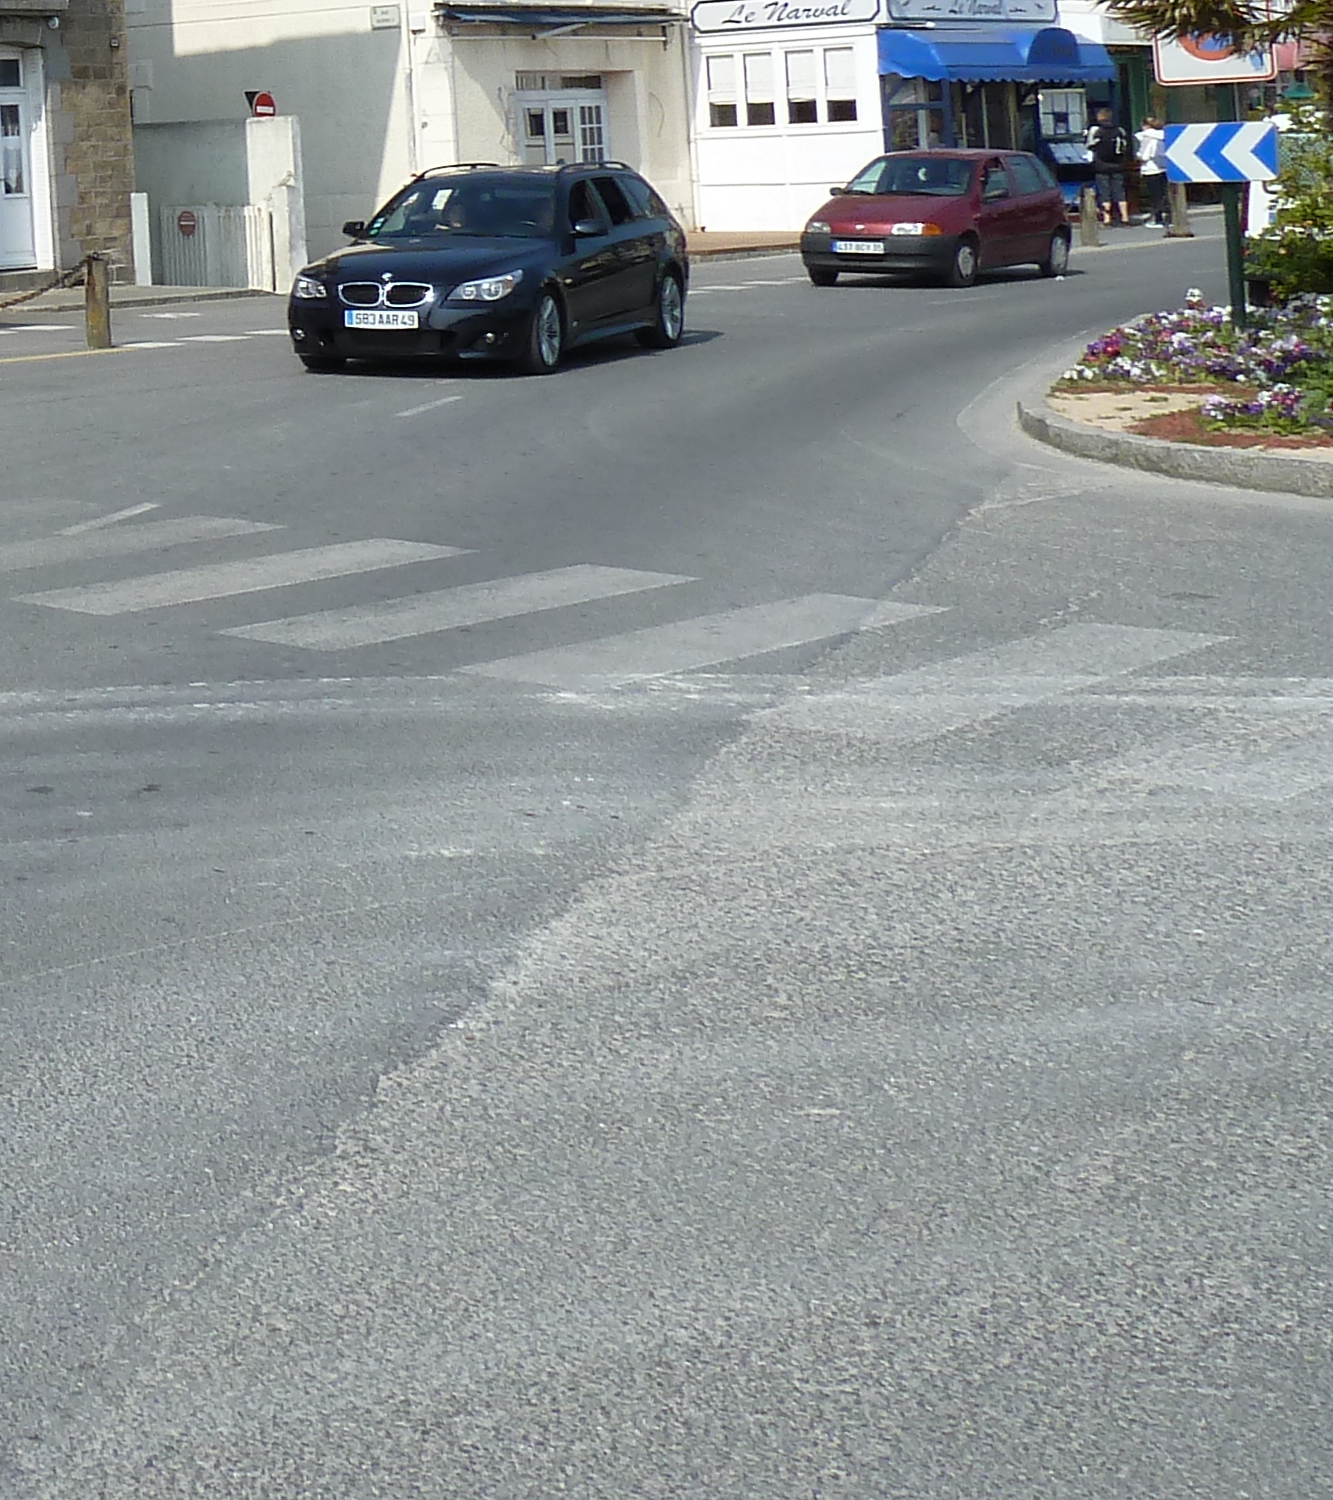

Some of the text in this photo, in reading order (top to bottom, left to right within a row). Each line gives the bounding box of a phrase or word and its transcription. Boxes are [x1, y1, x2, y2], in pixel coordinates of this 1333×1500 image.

[721, 4, 755, 24] Le
[355, 313, 415, 326] 583 AAR 49
